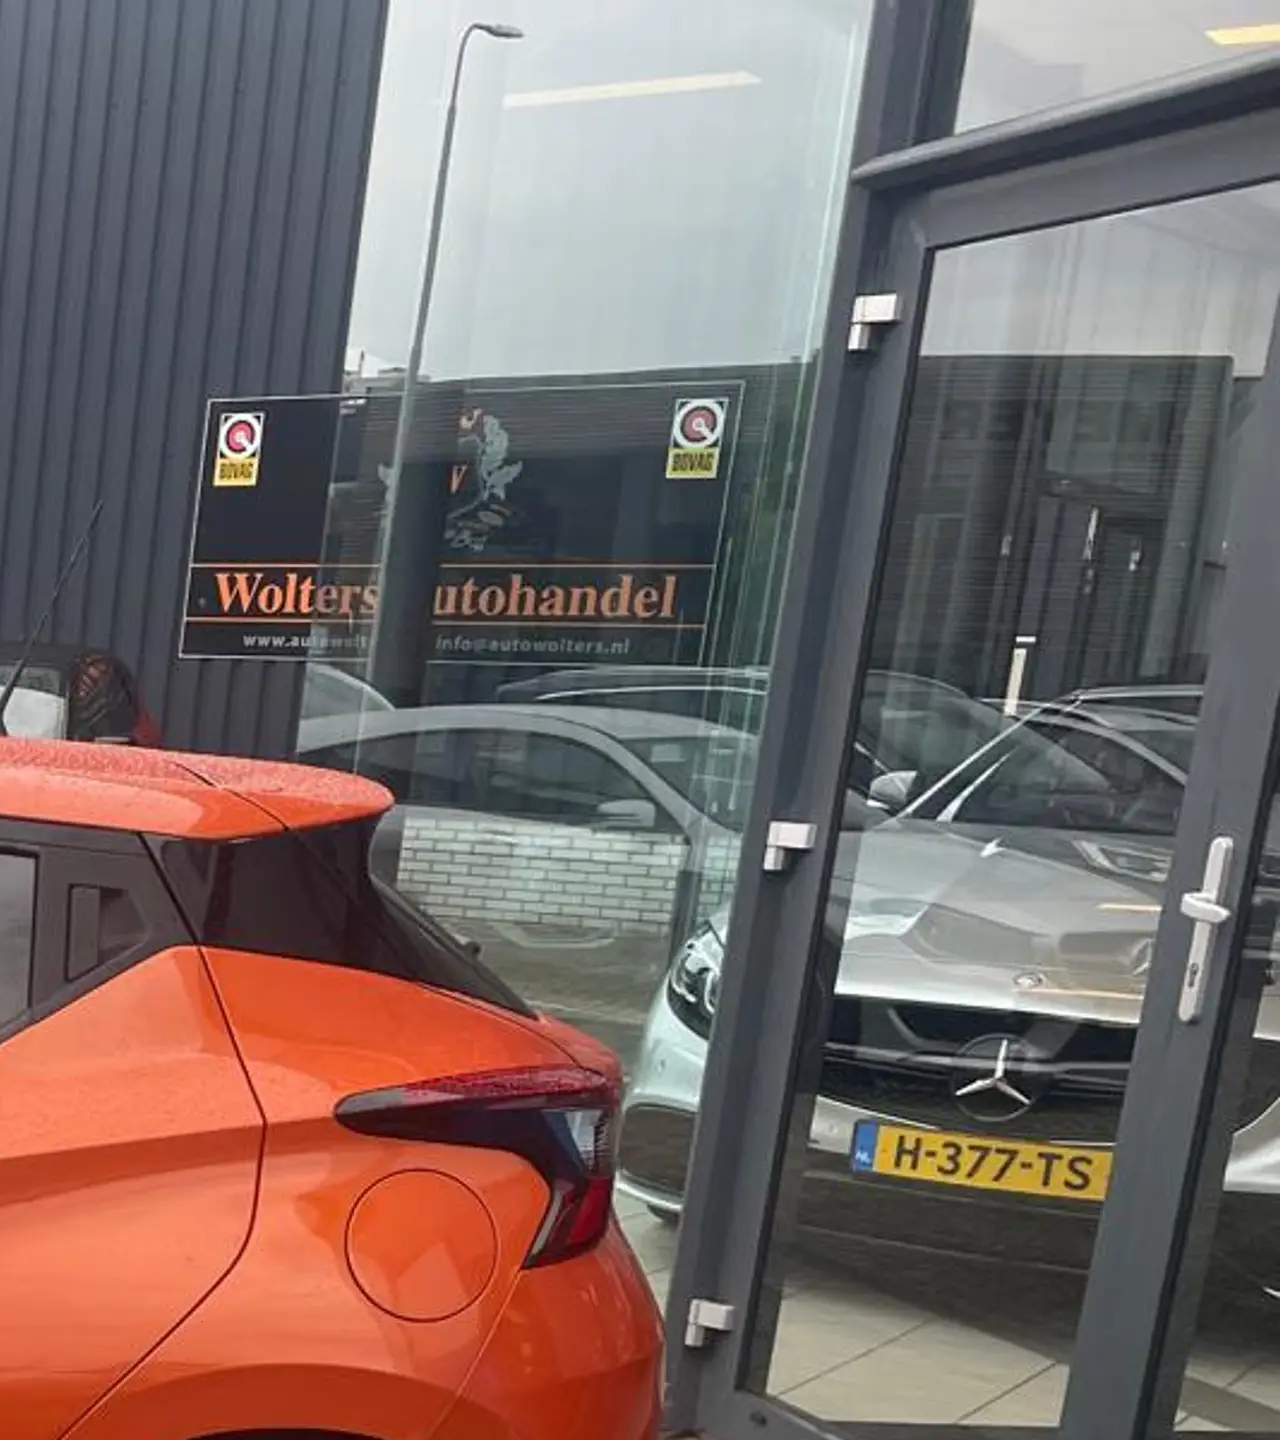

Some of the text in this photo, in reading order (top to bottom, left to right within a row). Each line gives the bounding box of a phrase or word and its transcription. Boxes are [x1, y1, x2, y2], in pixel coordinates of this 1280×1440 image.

[219, 462, 254, 479] BOVAG
[671, 451, 715, 473] BOVAG
[215, 572, 677, 619] Wolters utohandel
[894, 1135, 1093, 1190] H-377-TS
